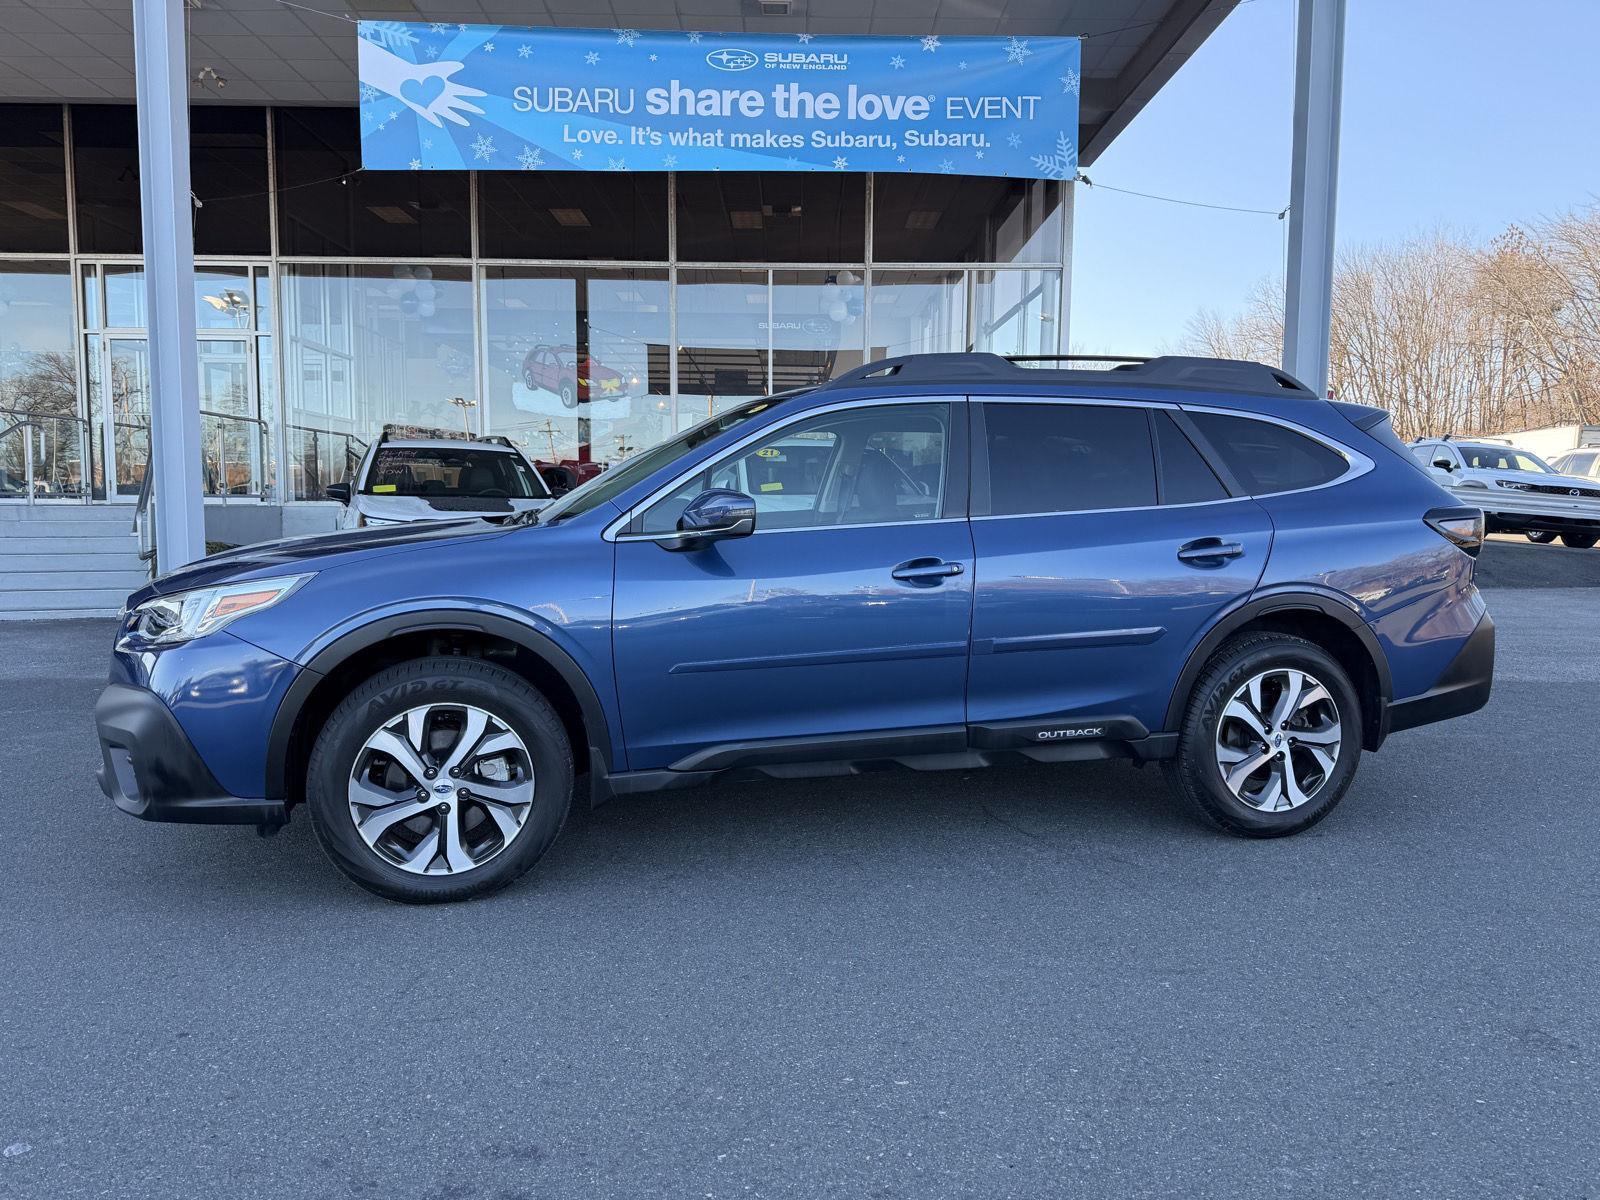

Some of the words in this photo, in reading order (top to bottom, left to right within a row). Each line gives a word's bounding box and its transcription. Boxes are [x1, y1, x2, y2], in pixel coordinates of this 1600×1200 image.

[764, 52, 848, 64] SUBARU
[512, 86, 635, 114] SUBARU
[645, 79, 765, 118] share
[771, 82, 841, 120] the
[946, 96, 1042, 120] EVENT
[563, 124, 624, 145] Love.
[630, 126, 663, 146] It's
[669, 127, 724, 148] what
[730, 130, 805, 149] makes
[810, 130, 897, 151] Subaru,
[903, 129, 992, 148] Subaru.
[366, 680, 428, 714] AVID
[431, 679, 465, 691] GT
[1038, 727, 1103, 739] OUTBACK
